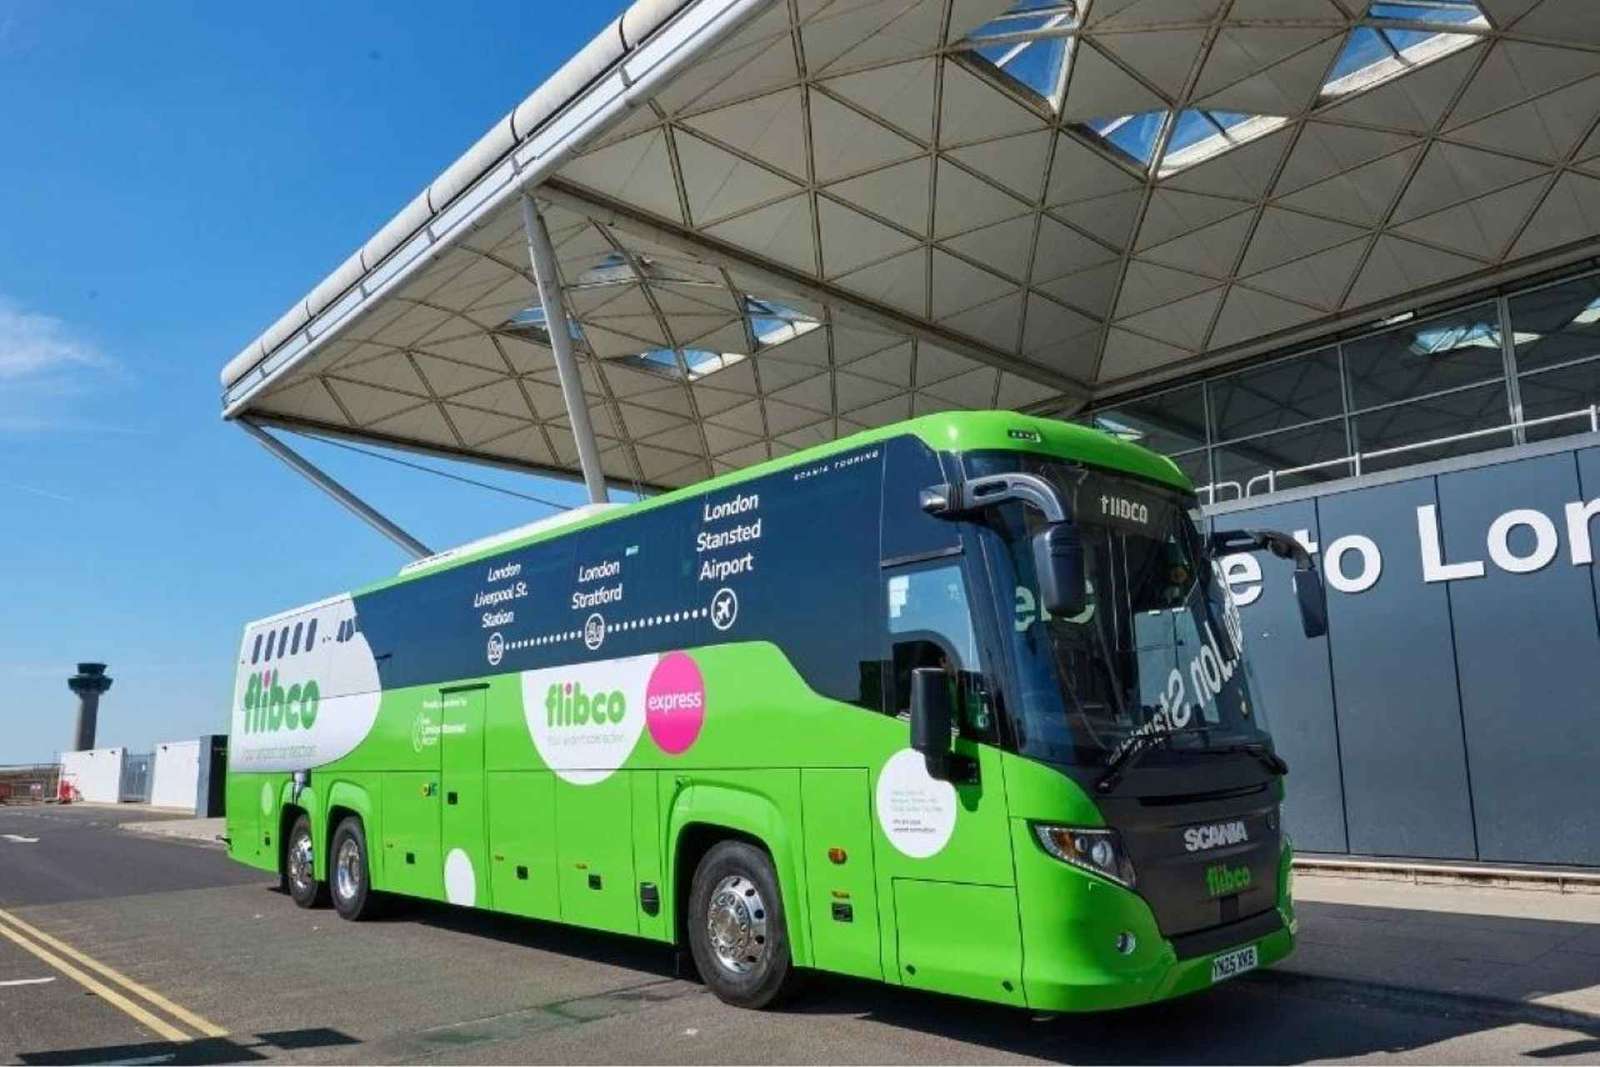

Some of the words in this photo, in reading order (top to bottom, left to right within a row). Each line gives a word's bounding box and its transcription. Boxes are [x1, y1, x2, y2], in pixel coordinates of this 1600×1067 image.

[834, 449, 879, 469] TOURING
[703, 494, 759, 522] London
[696, 519, 761, 552] Stansted
[487, 563, 521, 582] London
[578, 560, 620, 582] London
[699, 552, 754, 582] Airport
[473, 584, 514, 608] Liverpool
[571, 584, 623, 609] Stratford
[481, 610, 515, 628] Station
[244, 667, 320, 734] flibco
[545, 681, 626, 727] flibco
[648, 690, 702, 713] express
[1184, 821, 1248, 851] SCANIA
[1205, 863, 1250, 896] flibco
